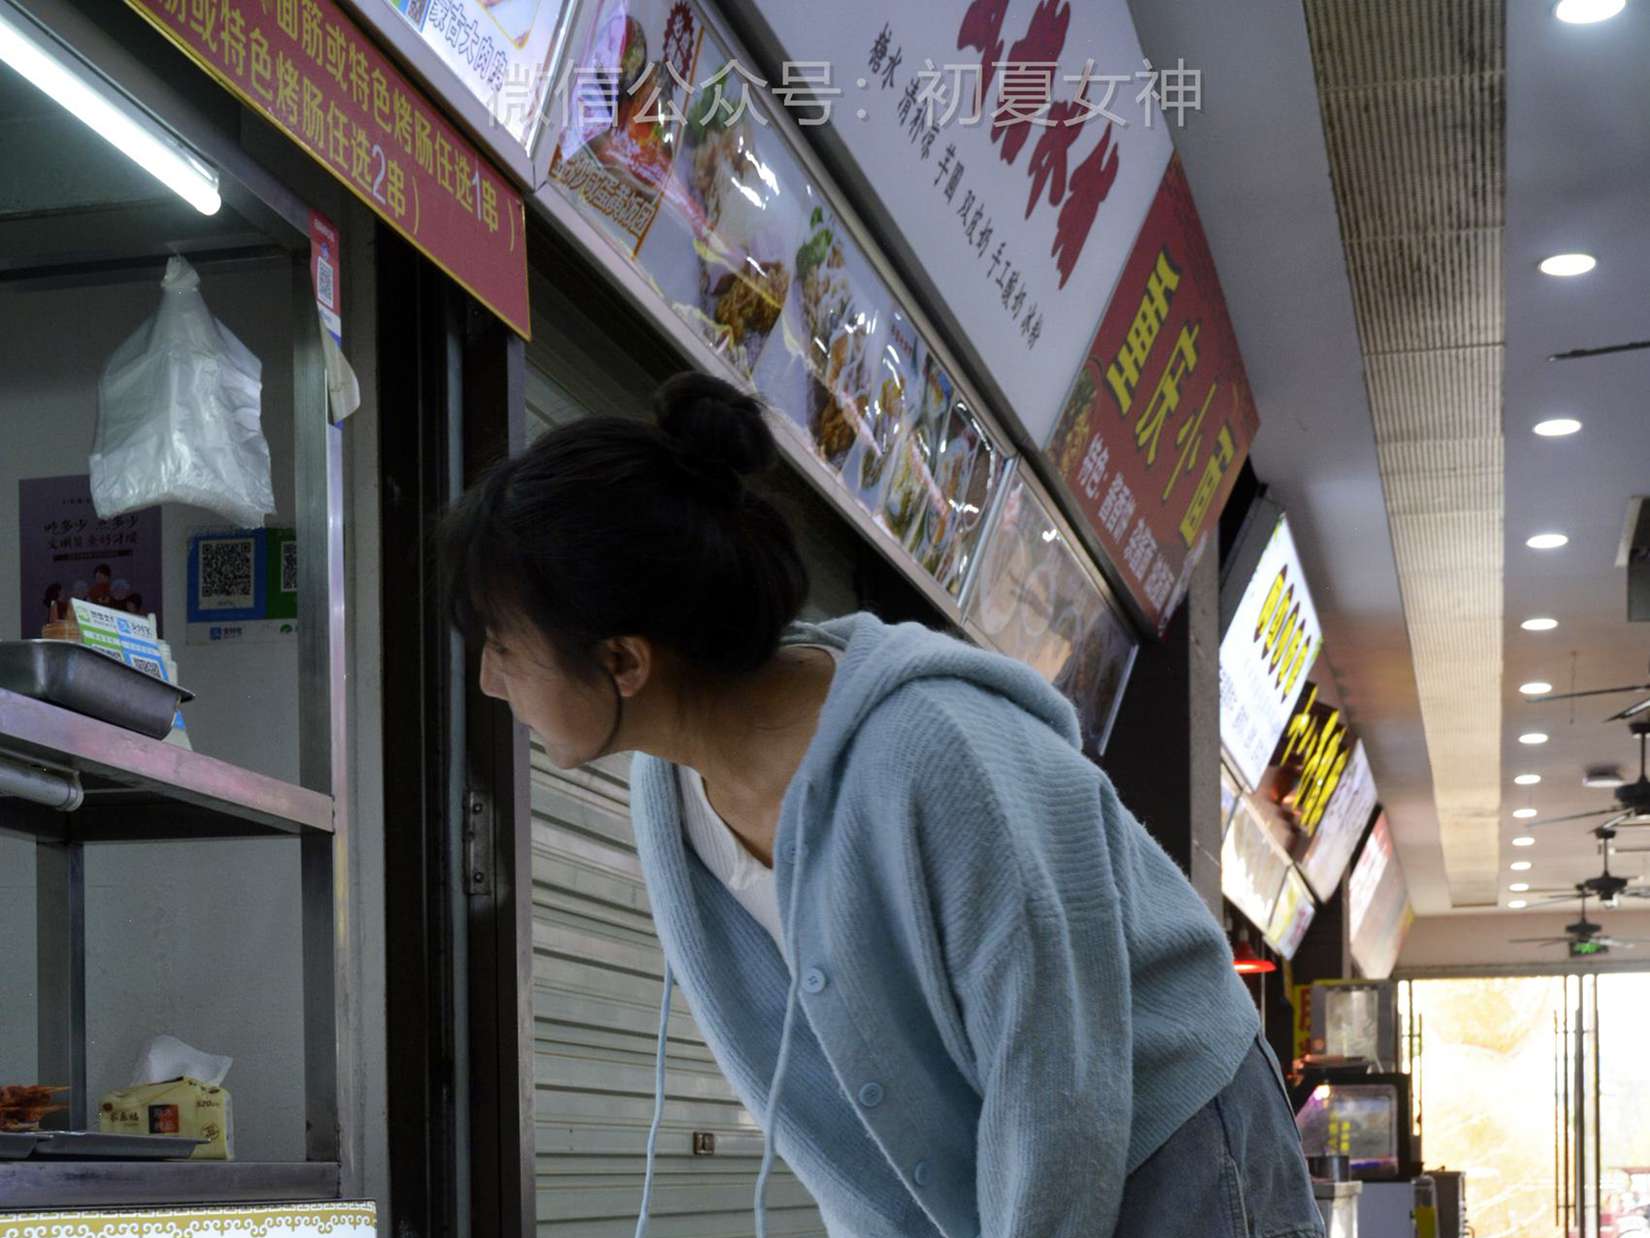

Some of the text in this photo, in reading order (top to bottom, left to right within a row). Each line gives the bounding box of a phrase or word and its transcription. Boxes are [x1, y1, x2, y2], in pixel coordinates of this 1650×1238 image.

[262, 0, 515, 252] 面筋或特色烤肠任选1串）
[1106, 245, 1237, 550] 重庆小面
